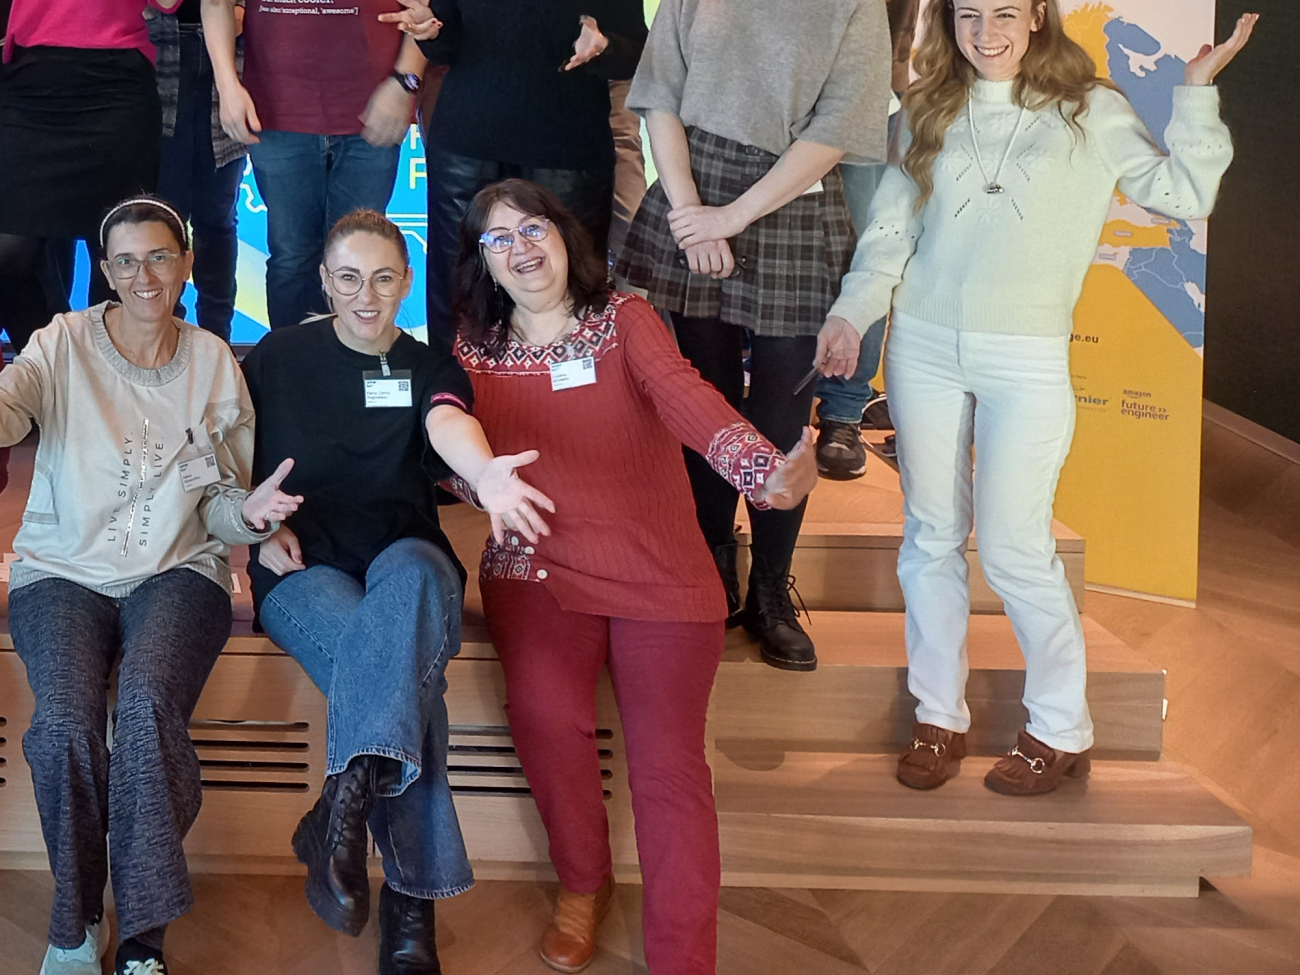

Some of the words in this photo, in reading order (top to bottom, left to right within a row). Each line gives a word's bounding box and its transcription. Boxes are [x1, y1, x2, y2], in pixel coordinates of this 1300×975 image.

[1123, 389, 1151, 398] amazon
[1121, 399, 1156, 413] future
[1121, 408, 1170, 420] engineer
[139, 487, 155, 547] SIMPLY
